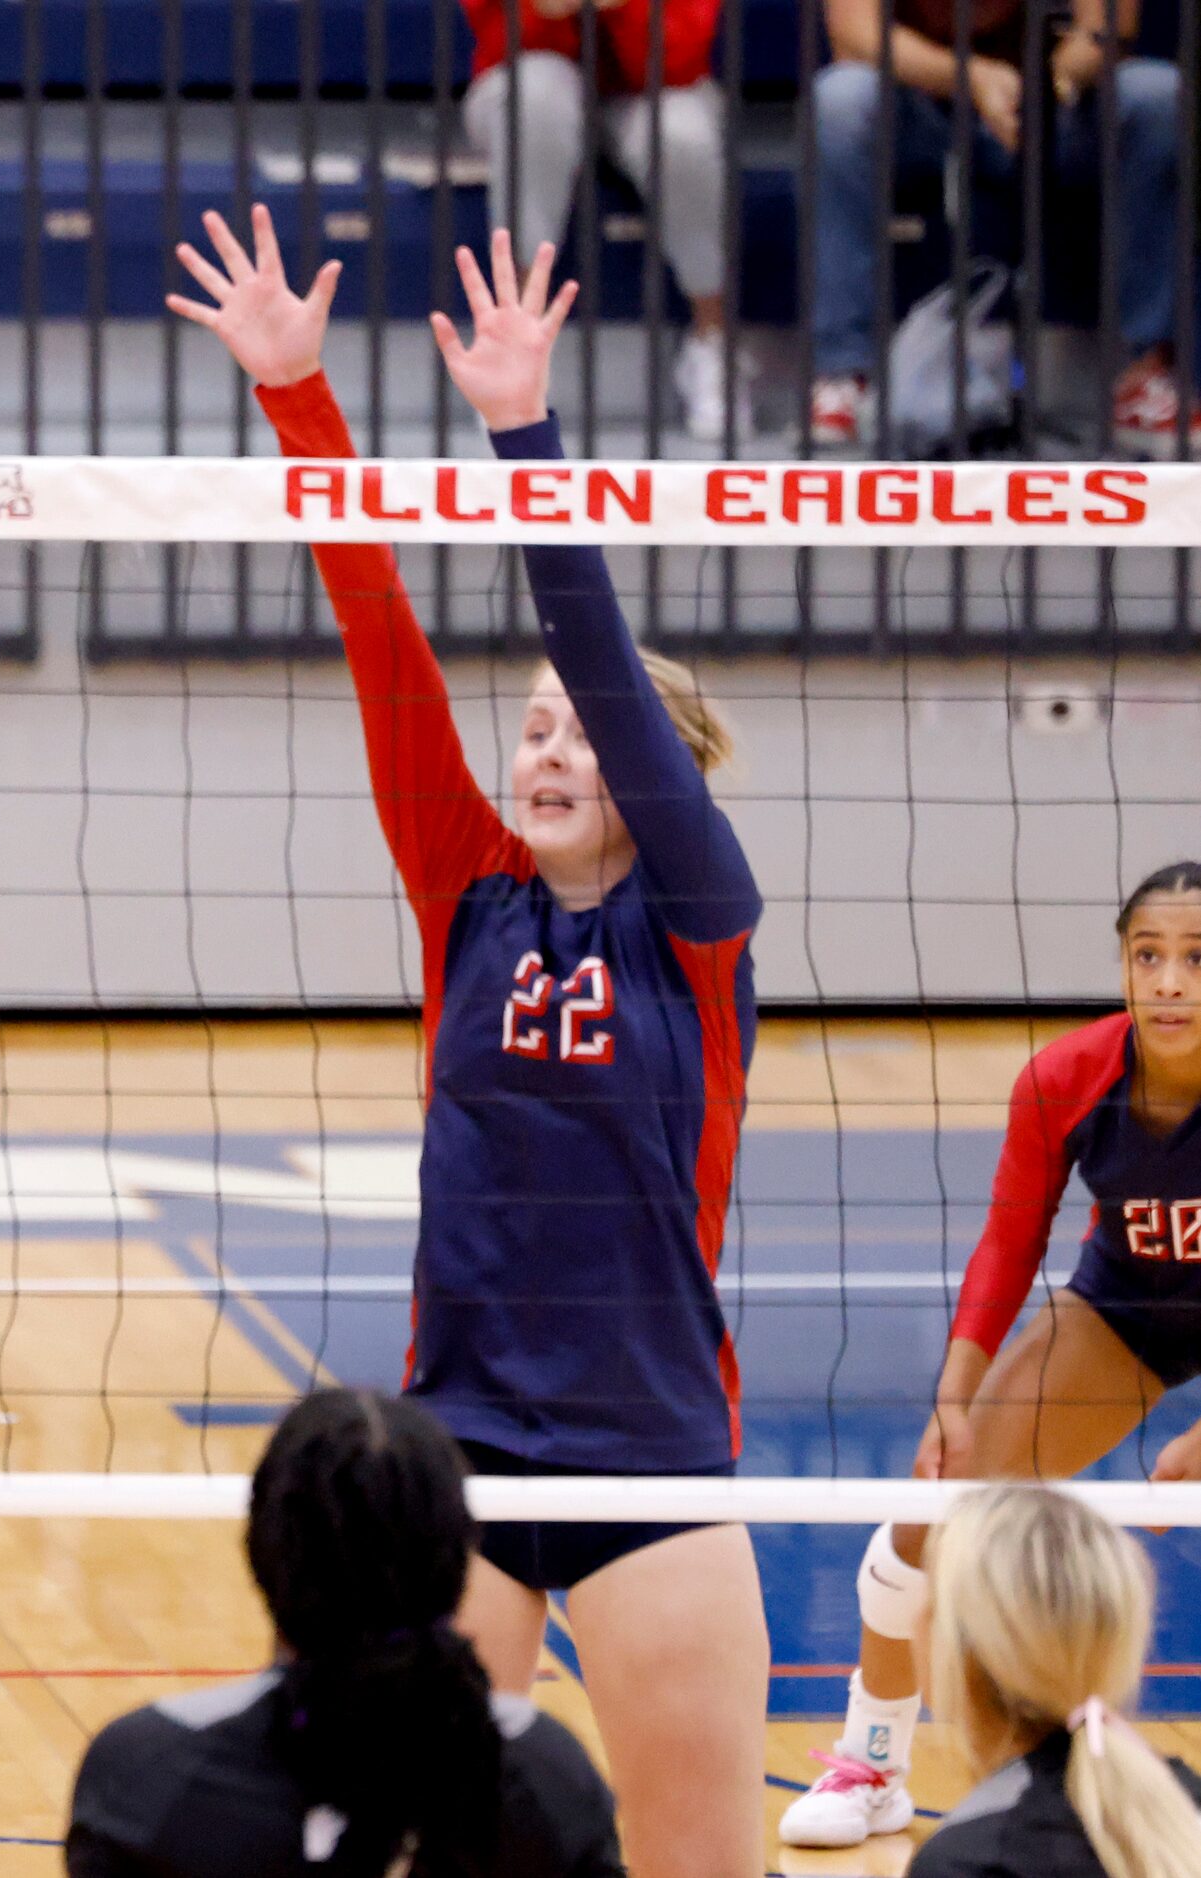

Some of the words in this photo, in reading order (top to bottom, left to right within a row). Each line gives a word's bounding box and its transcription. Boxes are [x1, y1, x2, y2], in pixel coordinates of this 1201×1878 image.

[285, 465, 653, 523] ALLEN
[705, 469, 1148, 525] EAGLES
[502, 950, 615, 1066] 22
